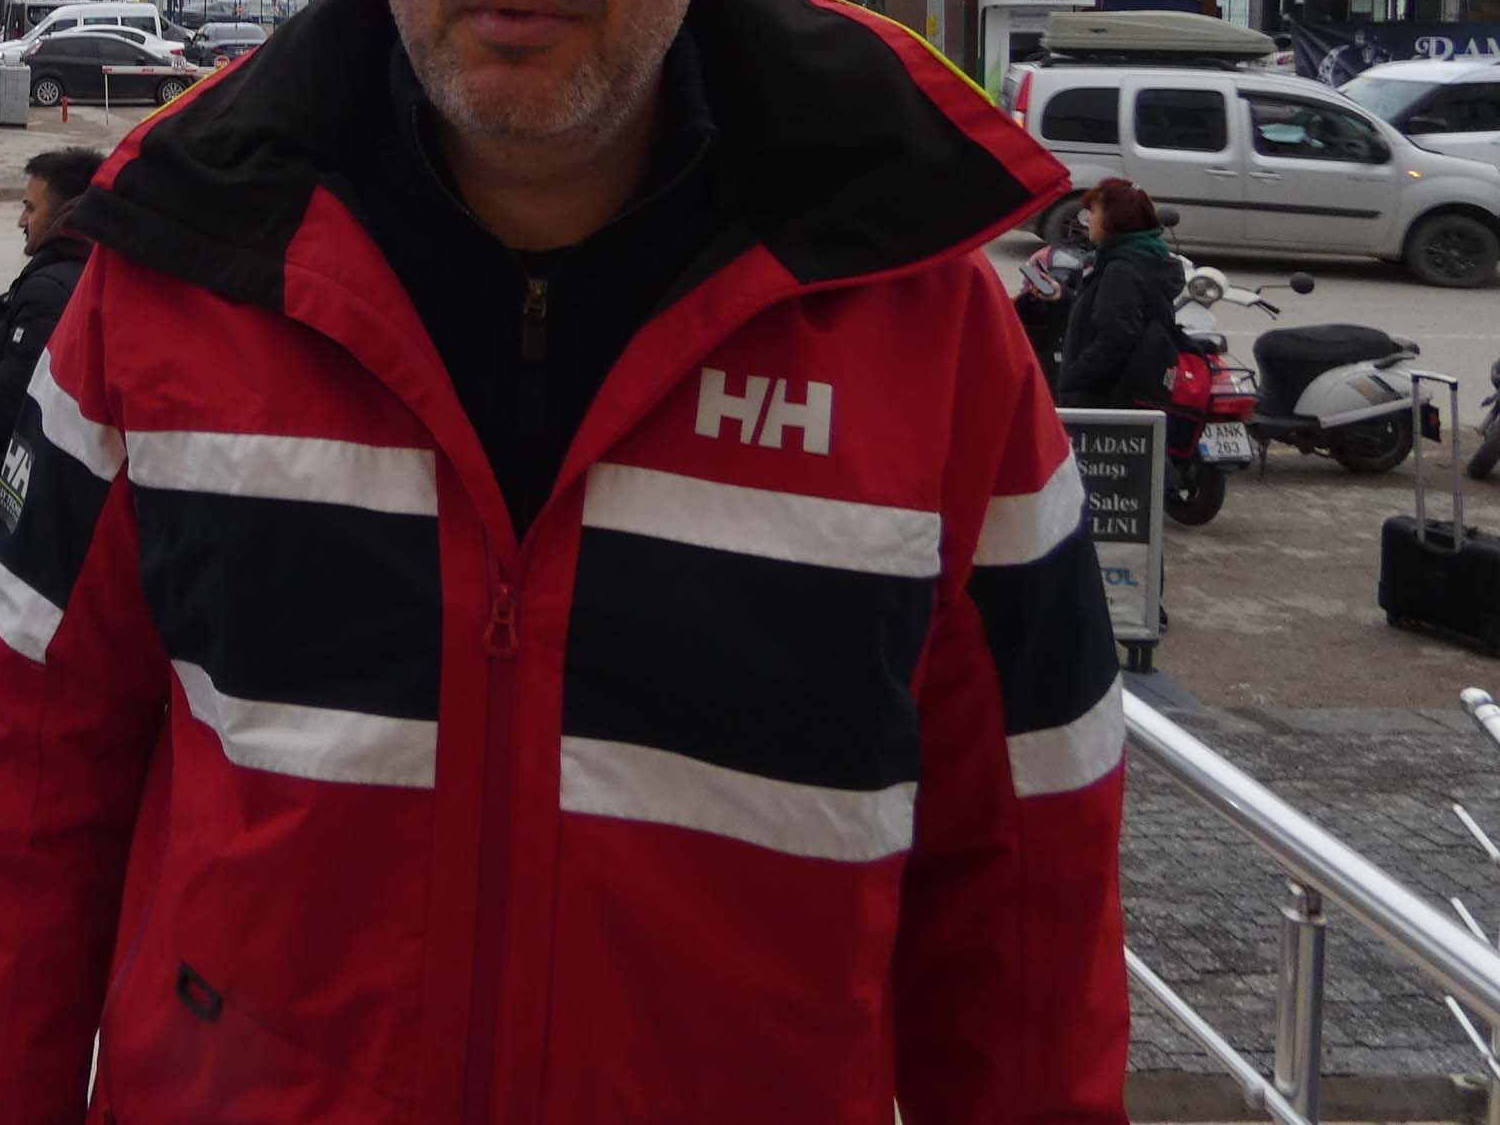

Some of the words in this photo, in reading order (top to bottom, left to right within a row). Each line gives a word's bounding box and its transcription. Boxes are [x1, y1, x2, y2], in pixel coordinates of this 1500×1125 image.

[695, 366, 833, 457] HH
[1216, 426, 1243, 437] ANK
[1089, 492, 1139, 512] Sales
